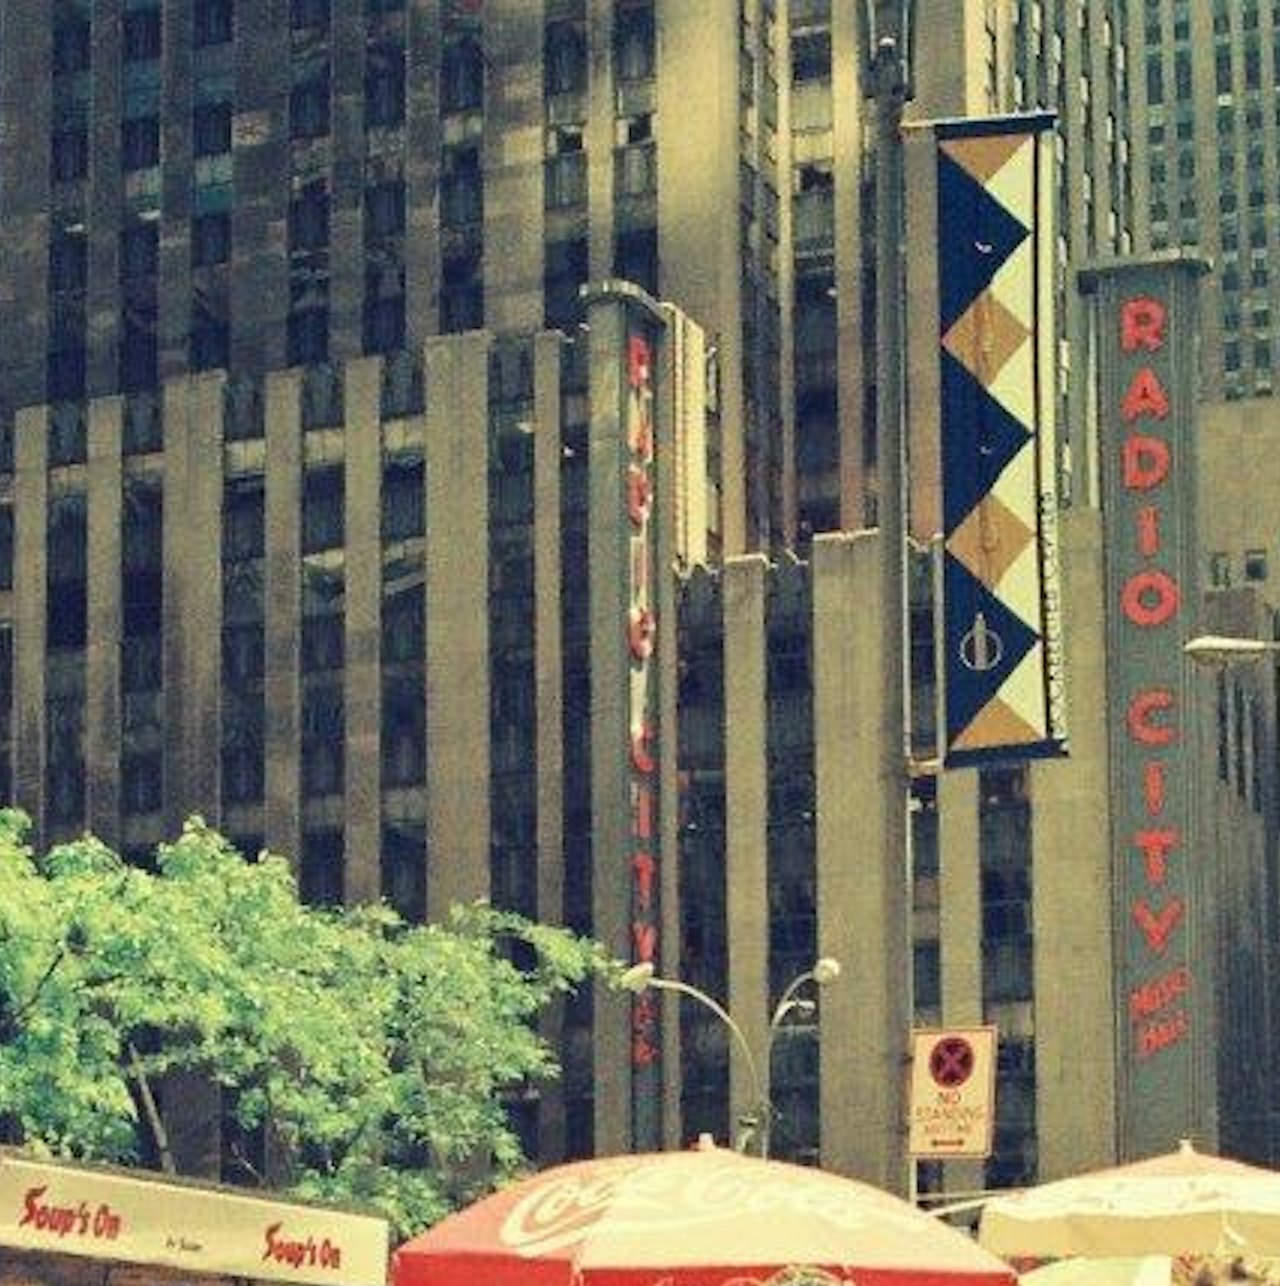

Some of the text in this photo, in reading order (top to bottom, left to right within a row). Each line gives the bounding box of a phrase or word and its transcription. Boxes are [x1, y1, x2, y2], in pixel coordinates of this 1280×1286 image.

[1120, 295, 1184, 955] RADIO CITY
[937, 1091, 962, 1104] NO
[19, 1185, 122, 1240] Soup's On
[261, 1221, 342, 1269] Soup's On
